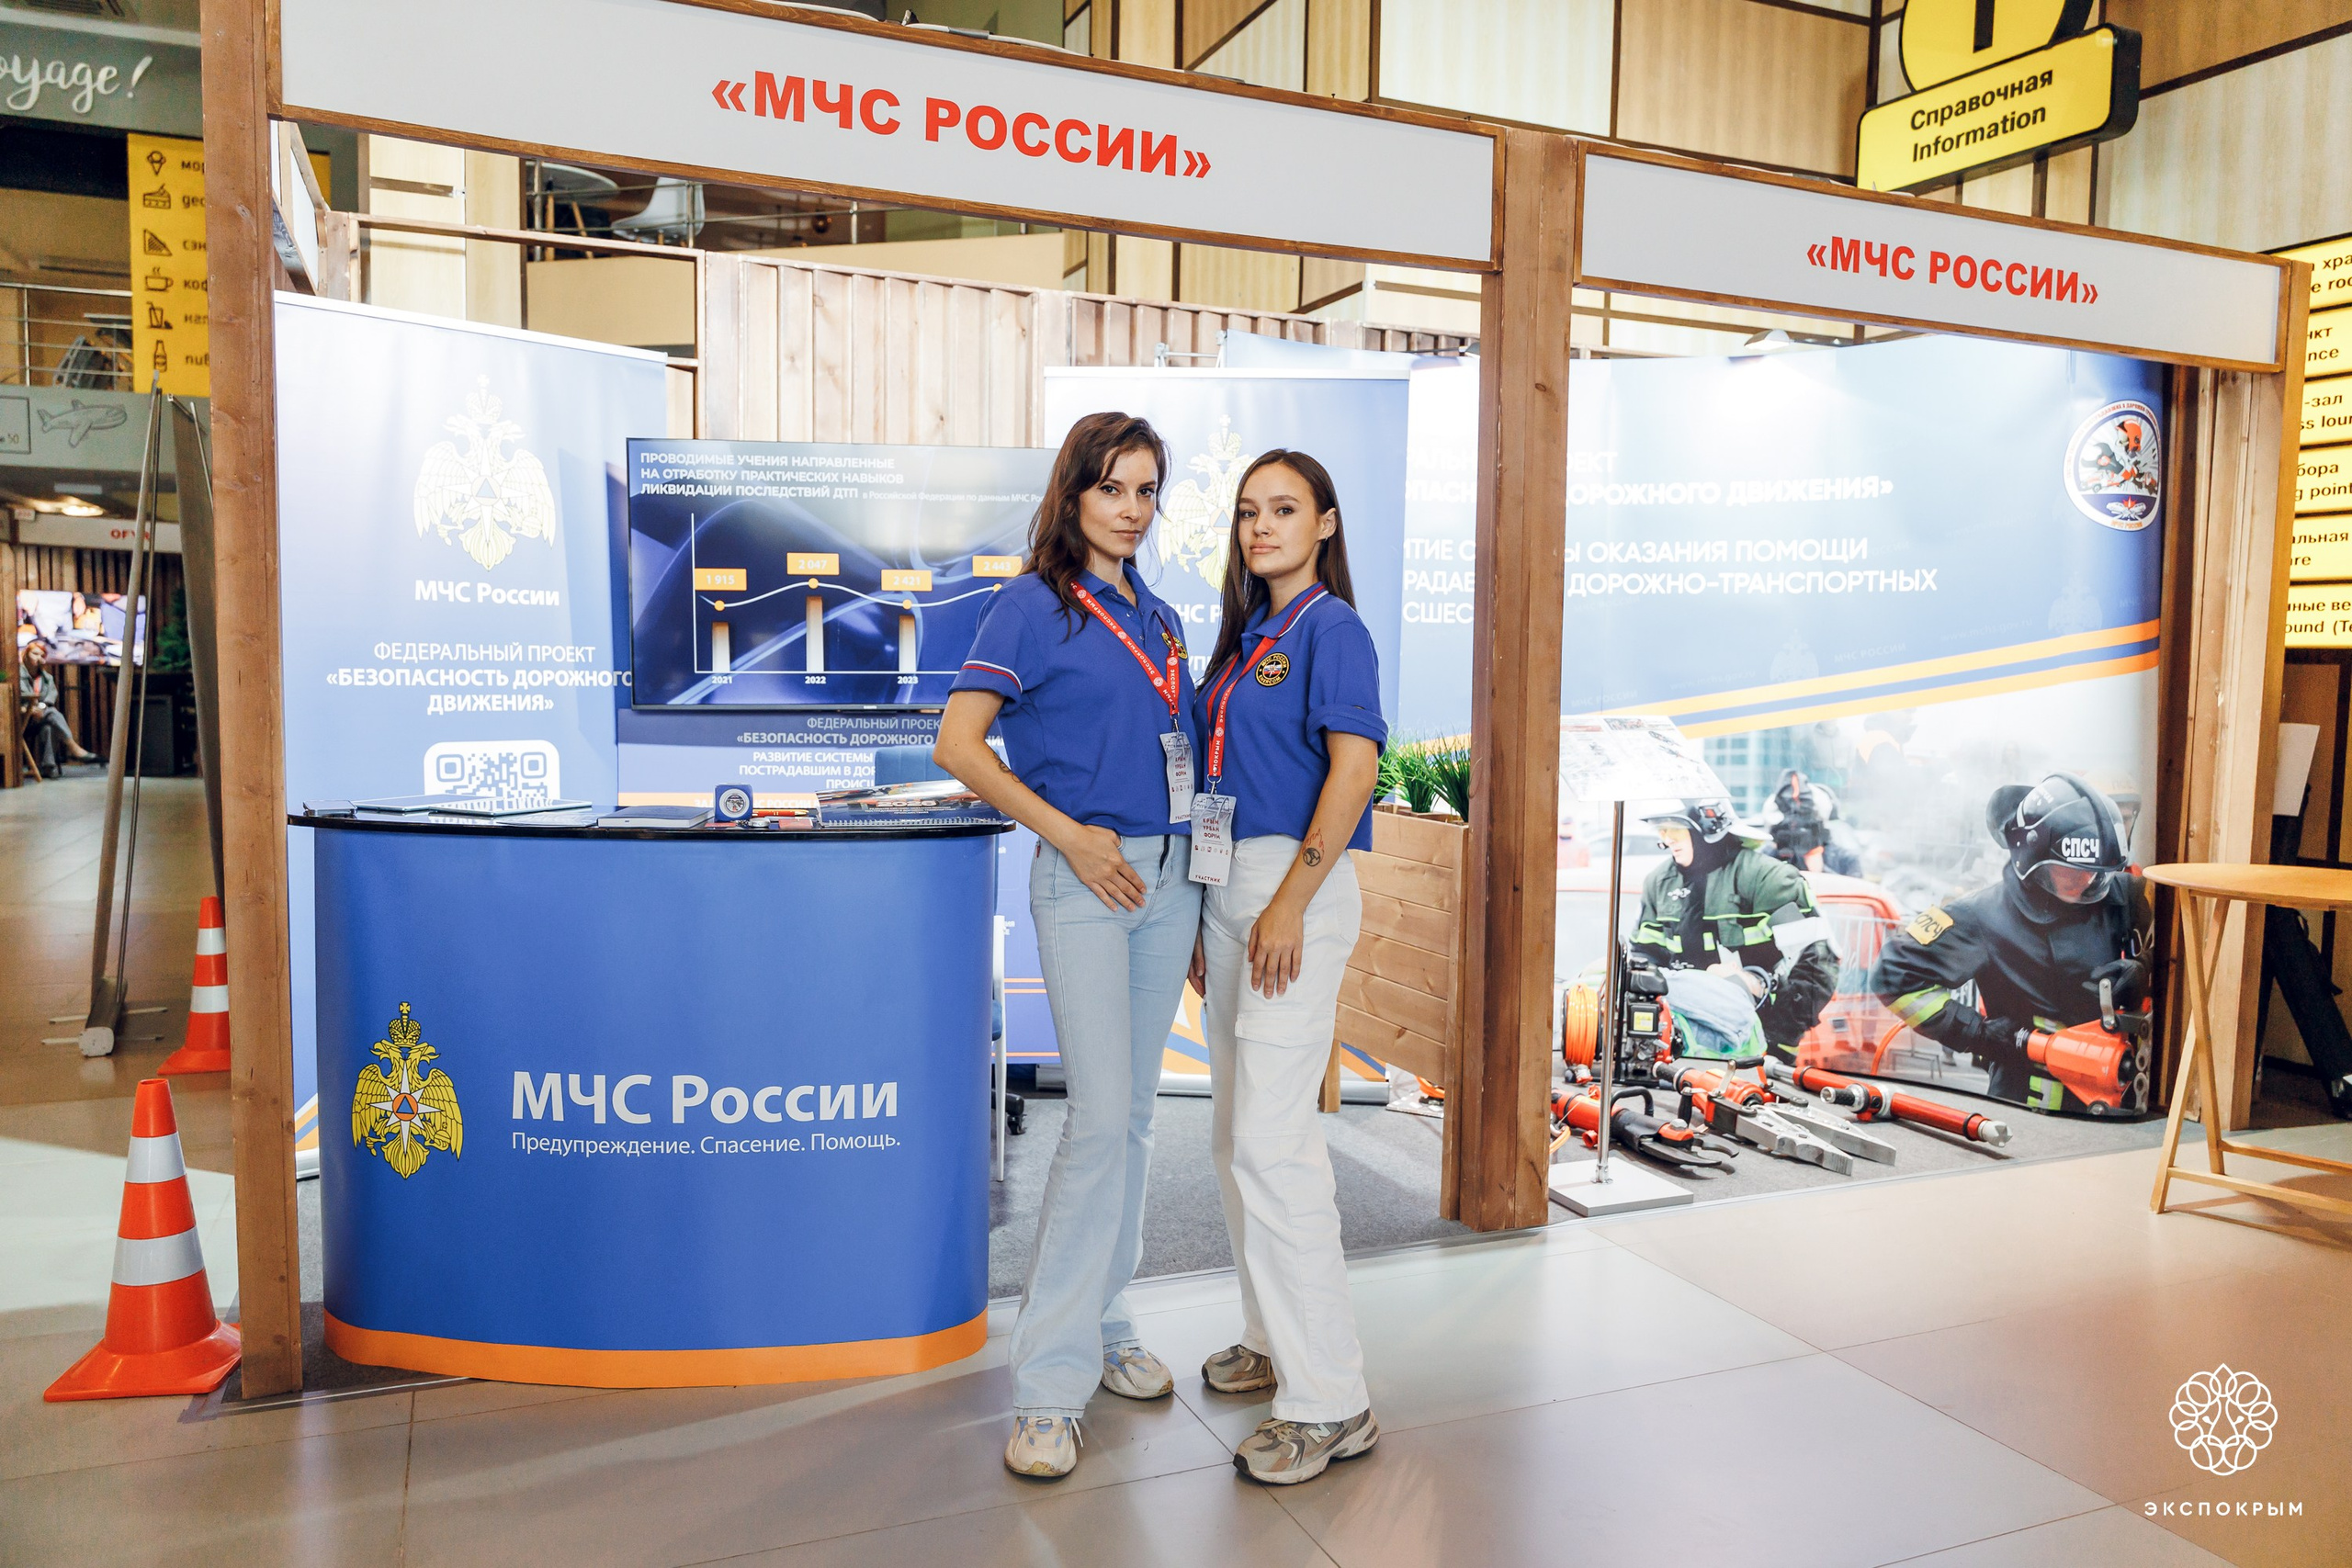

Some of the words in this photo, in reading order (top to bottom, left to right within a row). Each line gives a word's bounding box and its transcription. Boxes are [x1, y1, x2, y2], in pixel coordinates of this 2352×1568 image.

[1910, 69, 2053, 131] Справочная
[712, 70, 901, 135] «МЧС
[924, 96, 1212, 179] РОССИИ»
[1912, 106, 2046, 163] Information
[1806, 235, 1916, 281] «МЧС
[1928, 254, 2099, 306] РОССИИ»
[640, 453, 734, 466] ПРОВОДИМЫЕ
[737, 455, 788, 467] УЧЕНИЯ
[792, 457, 895, 469] НАПРАВЛЕННЫЕ
[640, 468, 660, 479] НА
[662, 468, 737, 481] ОТРАБОТКУ
[741, 470, 839, 483] ПРАКТИЧЕСКИХ
[842, 472, 904, 485] НАВЫКОВ
[640, 483, 732, 497] ЛИКВИДАЦИИ
[736, 484, 830, 498] ПОСЛЕДСТВИЙ
[833, 487, 858, 500] ДТП
[868, 491, 917, 501] Российской
[918, 491, 965, 502] Федерации
[1011, 493, 1030, 502] МЧС
[1566, 481, 1722, 506] ОРОЖНОГО
[1726, 475, 1894, 506] ДВИЖЕНИЯ»
[1587, 540, 1727, 563] ОКАЗАНИЯ
[1736, 537, 1869, 565] ПОМОЩИ
[415, 580, 470, 603] МЧС
[477, 582, 560, 606] России
[1567, 568, 1939, 597] ДОРОЖНО-ТРАНСПОРТНЫХ
[1085, 598, 1117, 630] ЭКСПОКРЫМ
[1174, 604, 1205, 624] ЧС
[374, 642, 524, 663] ФЕДЕРАЛЬНЫЙ
[527, 645, 595, 663] ПРОЕКТ
[1126, 640, 1155, 675] ЭКСПОКРЫМ
[326, 668, 509, 687] «БЕЗОПАСНОСТЬ
[513, 670, 632, 690] ДОРОЖНОГО
[711, 676, 732, 684] 2021
[805, 676, 826, 684] 2022
[897, 676, 919, 684] 2023
[426, 694, 555, 716] ДВИЖЕНИЯ»
[807, 716, 899, 730] ФЕДЕРАЛЬНЫЙ
[737, 733, 847, 744] «БЕЗОПАСНОСТЬ
[850, 733, 933, 746] ДОРОЖНОГО
[753, 752, 812, 762] РАЗВИТИЕ
[814, 752, 873, 763] СИСТЕМЫ
[739, 765, 842, 777] ПОСТРАДАВШИМ
[843, 766, 851, 776] В
[2061, 836, 2100, 858] СПСЧ
[511, 1070, 652, 1124] МЧС
[673, 1074, 899, 1124] России
[512, 1131, 695, 1158] Предупреждение.
[700, 1135, 806, 1156] Спасение.
[810, 1133, 901, 1154] Помощь.
